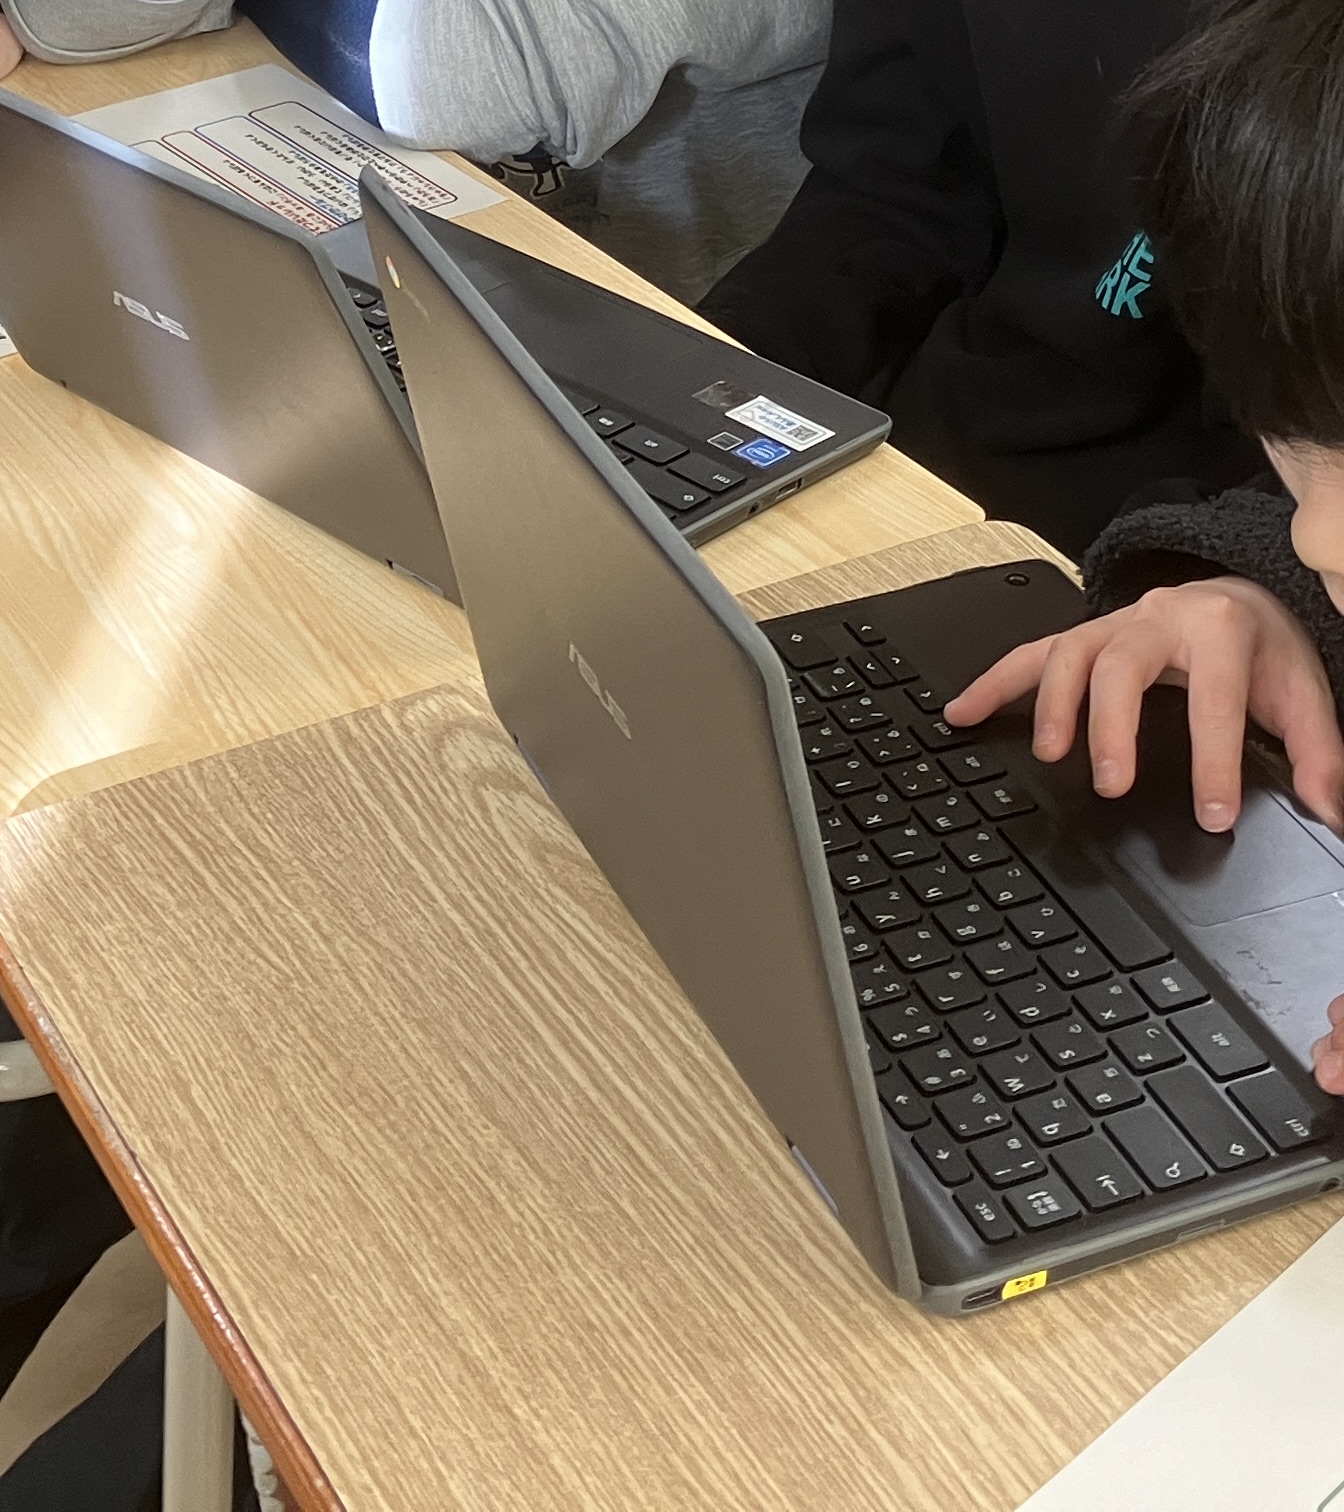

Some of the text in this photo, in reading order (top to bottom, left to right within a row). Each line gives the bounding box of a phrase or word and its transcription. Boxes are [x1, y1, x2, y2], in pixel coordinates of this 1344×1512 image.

[1211, 1032, 1231, 1046] alt
[1284, 1118, 1311, 1138] ctrl
[974, 1202, 996, 1222] esc
